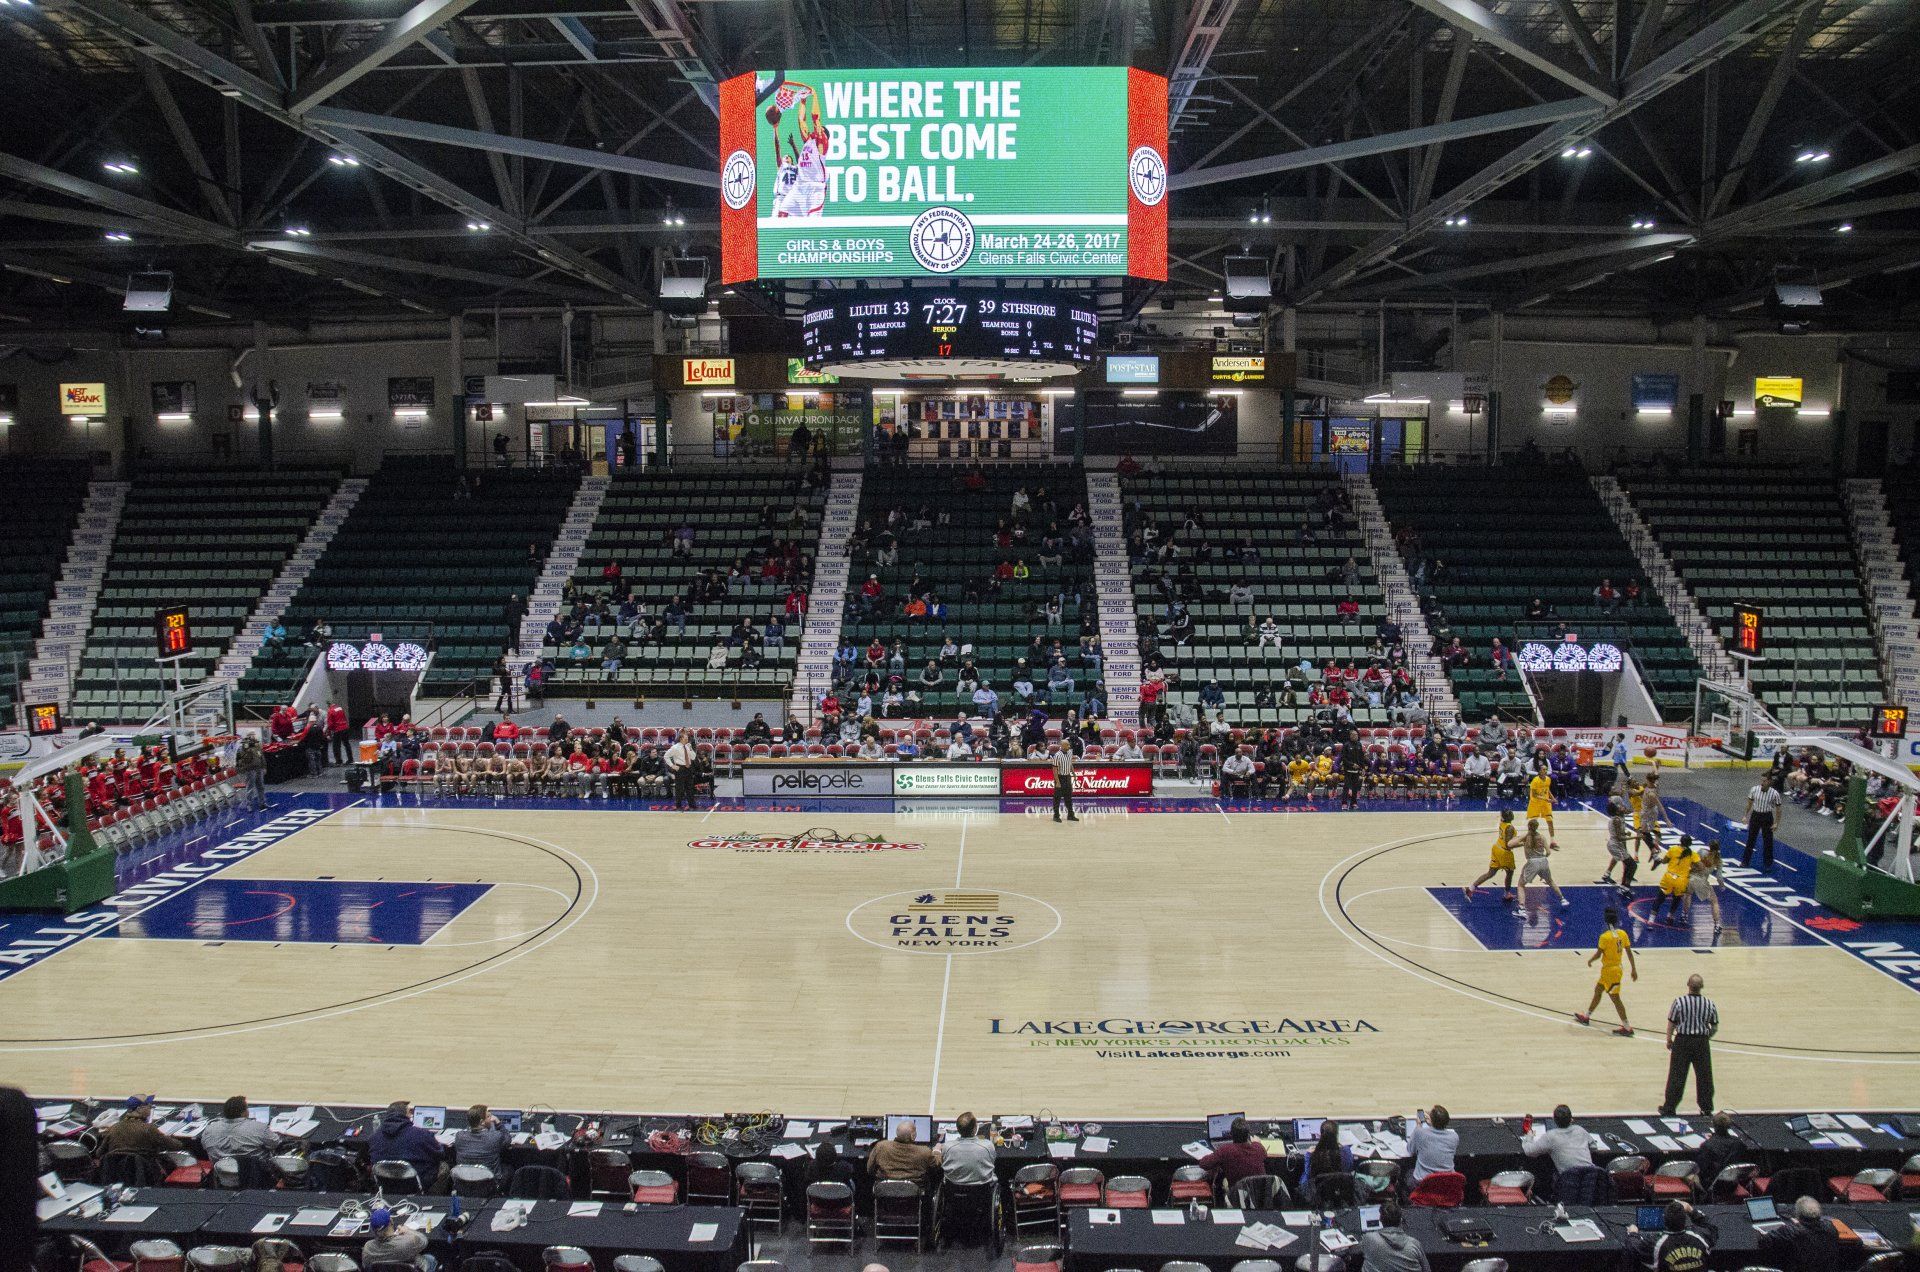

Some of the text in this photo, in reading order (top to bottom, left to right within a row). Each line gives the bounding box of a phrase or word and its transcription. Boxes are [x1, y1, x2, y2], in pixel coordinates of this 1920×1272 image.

[824, 81, 1021, 118] WHERE THE
[826, 124, 1017, 160] BEST COME
[828, 166, 975, 202] TO BALL.
[918, 210, 967, 228] NYS FEDERATION
[786, 238, 885, 252] GIRLS & BOYS
[980, 233, 1120, 252] March 24-26, 2017
[913, 233, 940, 268] TOURNAMENT
[950, 232, 970, 266] CHAMPIONS
[778, 251, 894, 264] CHAMPIONSHIPS
[978, 252, 1124, 264] Glens Falls Civic Center
[850, 301, 910, 318] LILUTH 33
[922, 304, 968, 324] 7:27
[978, 300, 1056, 317] 39 STHSHORE
[1070, 309, 1092, 324] LILUTH
[857, 322, 863, 331] 0
[1026, 320, 1032, 330] 0
[941, 333, 948, 341] 4
[938, 344, 952, 356] 17
[1212, 358, 1250, 367] Andersen
[686, 360, 731, 382] Leland
[67, 387, 88, 395] NBT
[72, 394, 100, 403] BANK
[722, 399, 731, 410] B
[971, 397, 980, 408] A
[166, 614, 184, 628] 7:27
[1742, 612, 1758, 628] 7:27
[170, 628, 186, 650] 17
[1741, 628, 1757, 650] 17
[35, 707, 56, 716] 7:27
[1883, 710, 1904, 720] 7:27
[38, 718, 54, 730] 17
[1886, 720, 1898, 733] 17
[772, 770, 863, 793] pellepelle
[915, 775, 935, 783] Glens
[1024, 776, 1054, 789] Glens
[1081, 776, 1130, 789] National
[200, 808, 334, 867] CENTER
[690, 840, 924, 850] Great Escape
[102, 862, 224, 906] CIVIC
[890, 914, 1014, 926] GLENS
[892, 926, 1010, 938] FALLS
[0, 912, 121, 978] ALLS
[1104, 1038, 1170, 1046] YORK'S
[1177, 1038, 1350, 1046] ADIRONDACKS
[1096, 1049, 1291, 1059] VisitLakeGeorge.com
[1664, 1246, 1702, 1264] WINDSOR
